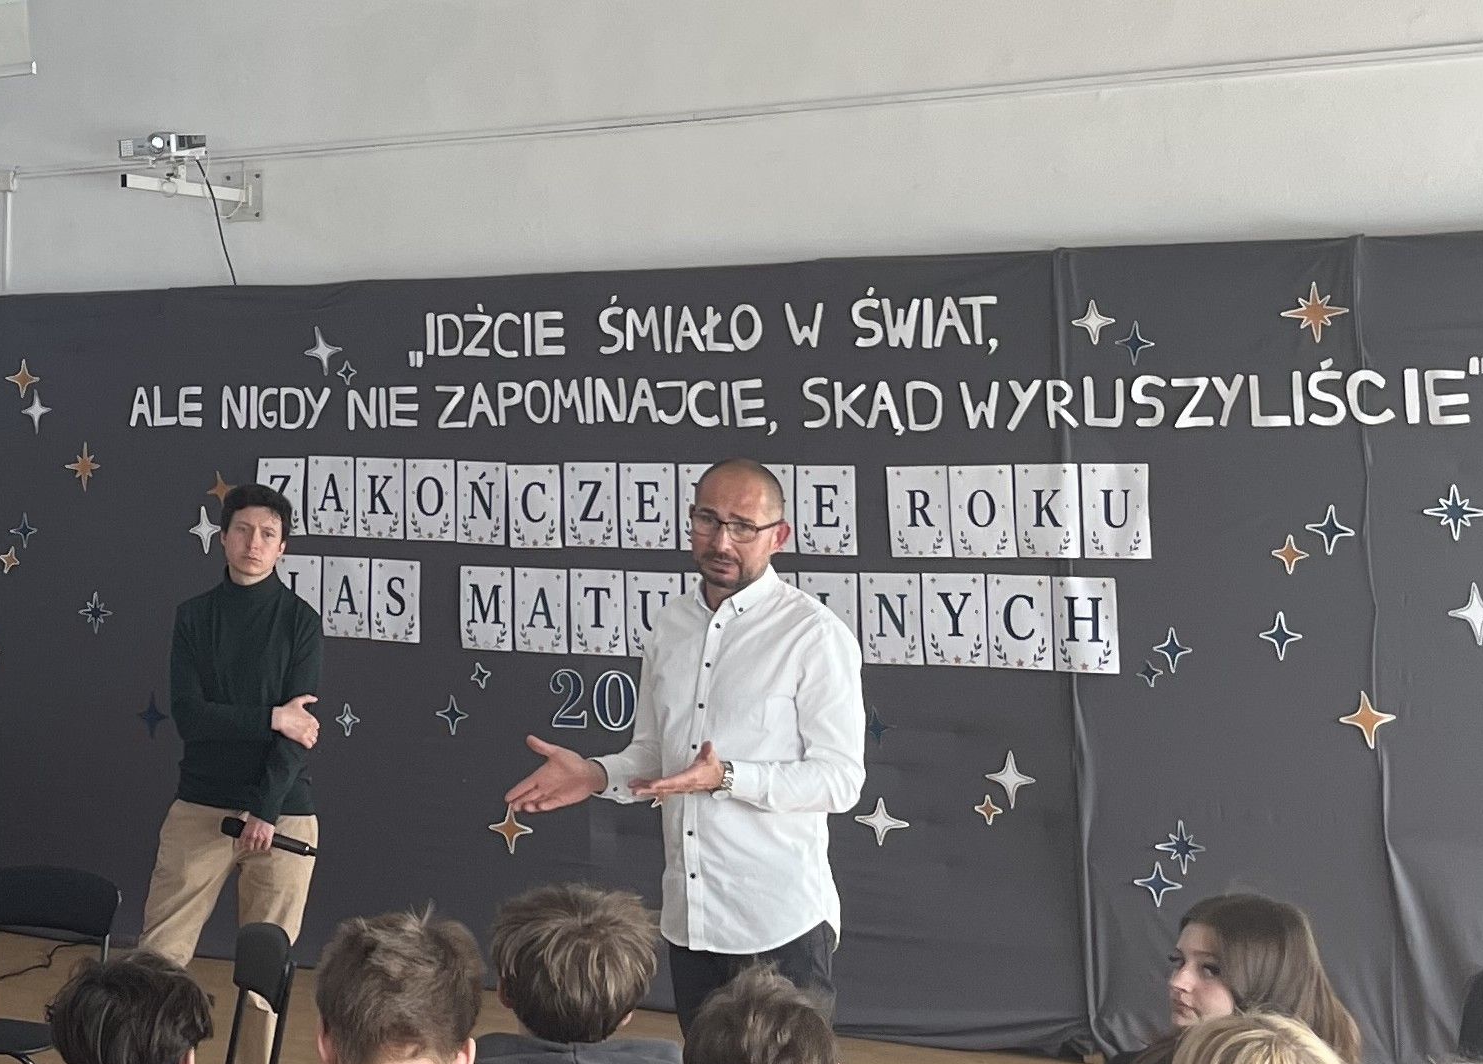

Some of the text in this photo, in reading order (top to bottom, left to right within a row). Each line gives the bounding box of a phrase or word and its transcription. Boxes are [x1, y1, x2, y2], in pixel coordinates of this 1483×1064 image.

[598, 295, 763, 354] ŚMIAŁO
[785, 302, 824, 348] W
[851, 286, 999, 356] ŚWIAT,
[129, 385, 202, 428] ALE
[221, 384, 331, 430] NIGDY
[347, 384, 419, 430] NIE
[435, 377, 778, 436] ZAPOMINAJCIE,
[802, 377, 943, 436] SKĄD
[269, 472, 1130, 529] ZAKOŃCZEE ROKU
[549, 668, 638, 731] 20
